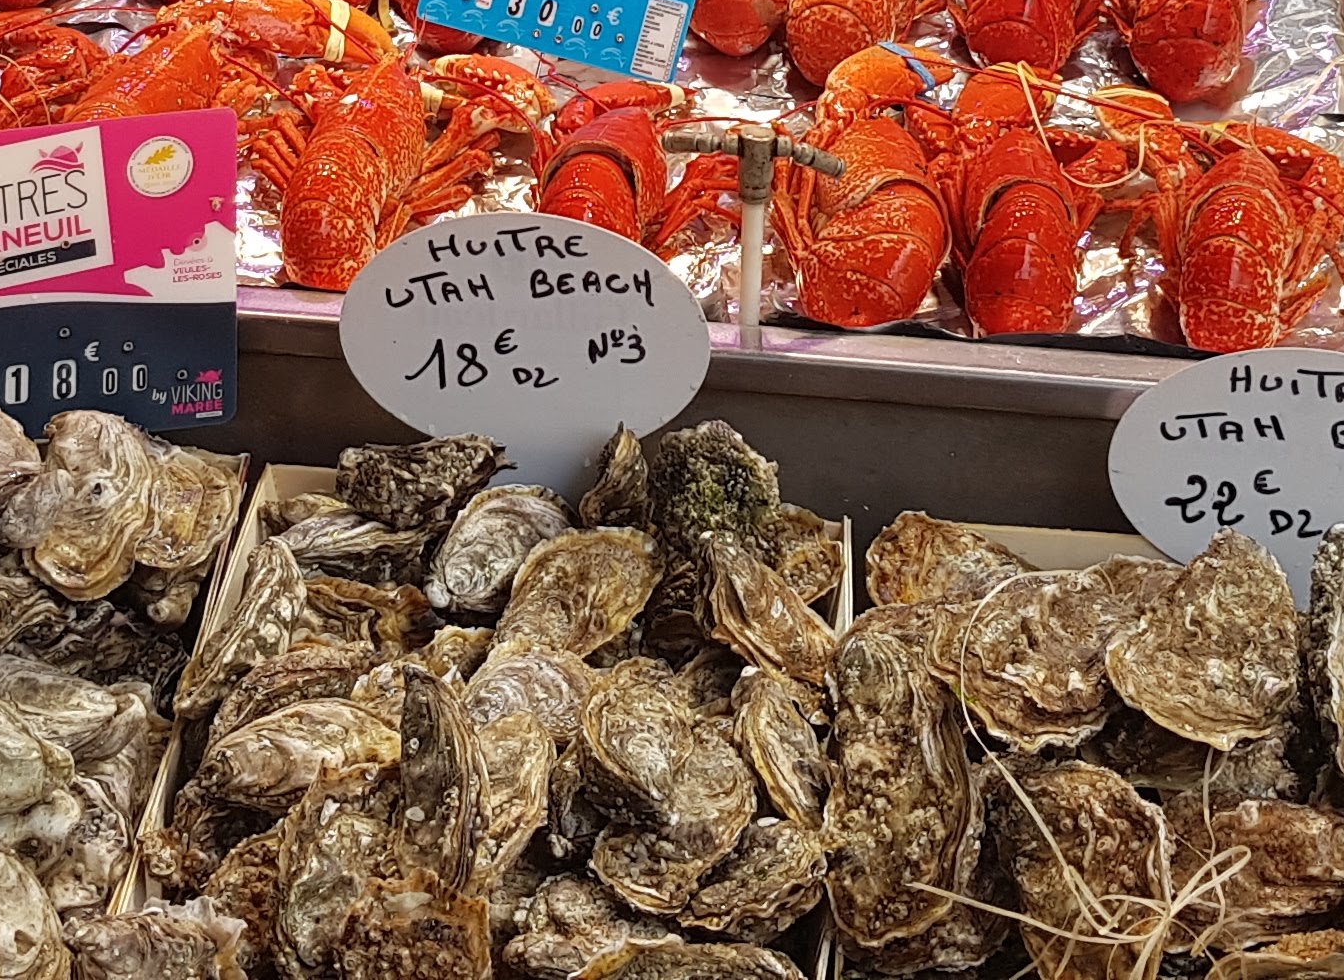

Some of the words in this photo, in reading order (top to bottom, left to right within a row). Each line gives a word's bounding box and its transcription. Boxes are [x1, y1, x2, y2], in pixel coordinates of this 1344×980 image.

[607, 7, 623, 26] €
[428, 226, 589, 262] HUITRE
[385, 271, 495, 308] UTAH
[530, 269, 654, 307] BEACH
[84, 341, 100, 362] €
[405, 338, 488, 390] 18
[151, 388, 167, 405] by
[171, 381, 222, 405] VIKING
[1160, 411, 1286, 442] UTAH
[1164, 474, 1244, 526] 22
